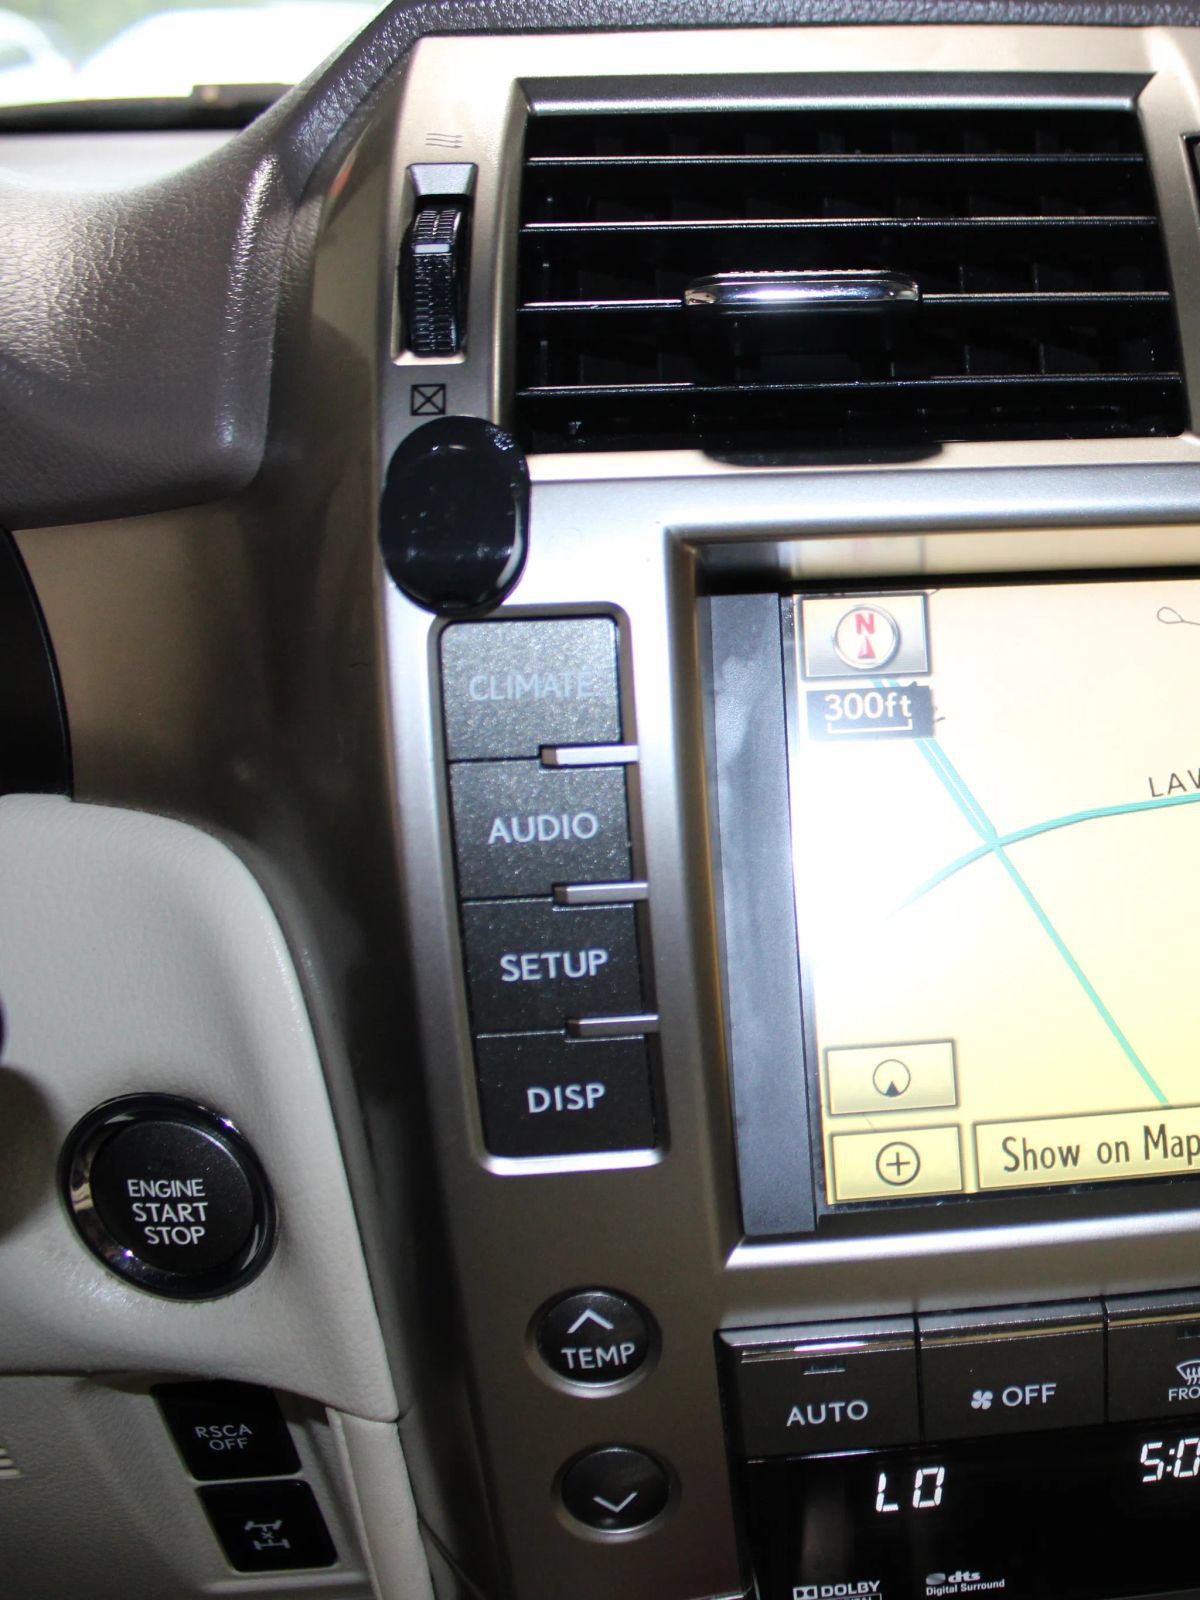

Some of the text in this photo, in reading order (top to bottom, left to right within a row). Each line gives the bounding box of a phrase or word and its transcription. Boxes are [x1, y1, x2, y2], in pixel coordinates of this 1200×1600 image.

[855, 612, 875, 635] N
[469, 668, 599, 703] CLIMATE
[823, 691, 912, 721] 300ft
[488, 812, 600, 845] AUDIO
[500, 950, 608, 982] SETUP
[526, 1083, 606, 1114] DISP
[1001, 1134, 1082, 1173] Show
[1096, 1138, 1130, 1164] on
[127, 1178, 205, 1198] ENGINE
[131, 1202, 208, 1224] START
[144, 1226, 206, 1246] STOP
[562, 1343, 636, 1370] TEMP
[1001, 1383, 1057, 1407] OFF
[785, 1400, 869, 1428] AUTO
[194, 1424, 254, 1439] RSCA
[208, 1437, 250, 1452] OFF
[821, 1580, 881, 1595] DOLBY
[926, 1577, 1006, 1596] Digital Surround
[946, 1570, 982, 1584] dts
